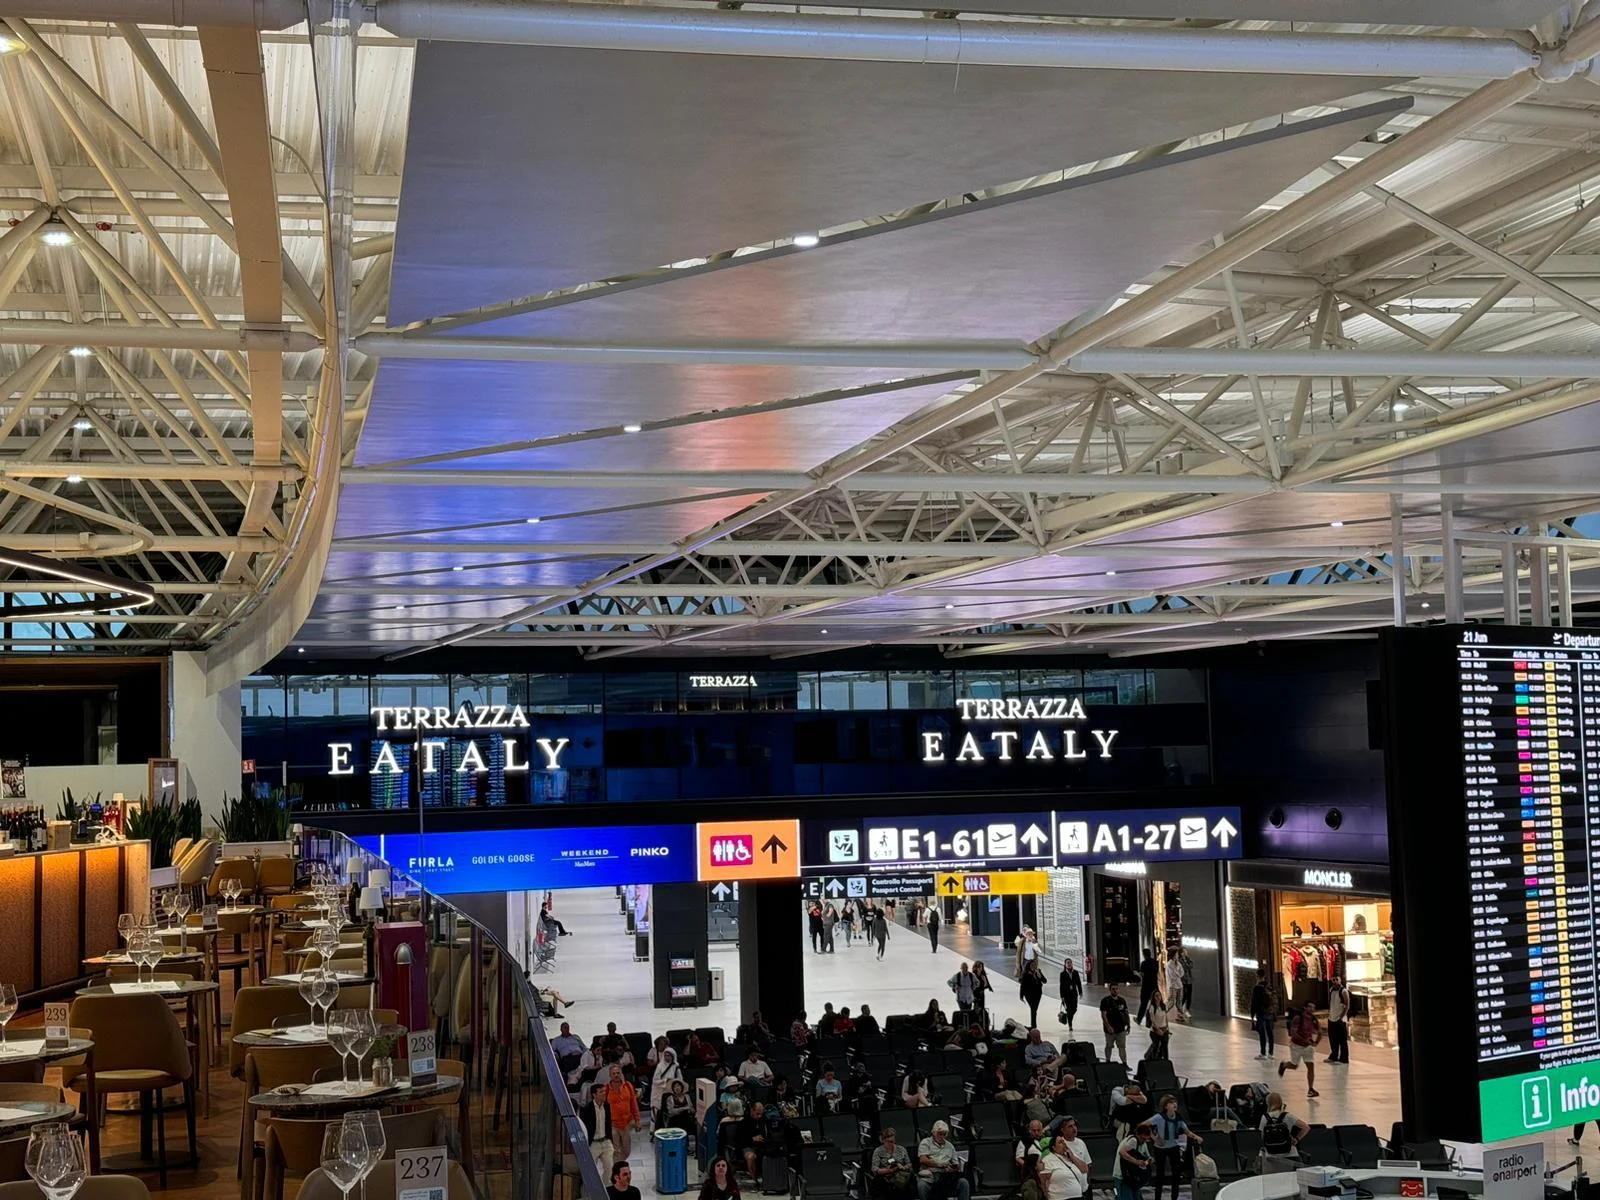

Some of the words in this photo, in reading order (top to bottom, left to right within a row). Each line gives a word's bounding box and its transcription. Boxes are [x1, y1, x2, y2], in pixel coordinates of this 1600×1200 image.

[1463, 631, 1473, 643] 21
[689, 675, 758, 688] TERRAZZA
[955, 697, 1087, 720] TERRAZZA
[372, 704, 530, 730] TERRAZZA
[922, 730, 1119, 761] EATALY
[327, 738, 570, 776] EATALY
[471, 855, 505, 865] GOLDEN
[508, 853, 535, 864] GOOSE
[560, 849, 609, 857] WEEKEND
[630, 847, 669, 857] PINKO
[409, 856, 454, 868] FURLA
[1304, 869, 1353, 887] MONCLER
[899, 885, 922, 893] Control
[46, 1008, 67, 1021] 239
[411, 1035, 434, 1052] 238
[1560, 1076, 1600, 1112] Info
[401, 1155, 444, 1179] 237
[1499, 1154, 1523, 1168] radio
[1493, 1164, 1537, 1182] onairport
